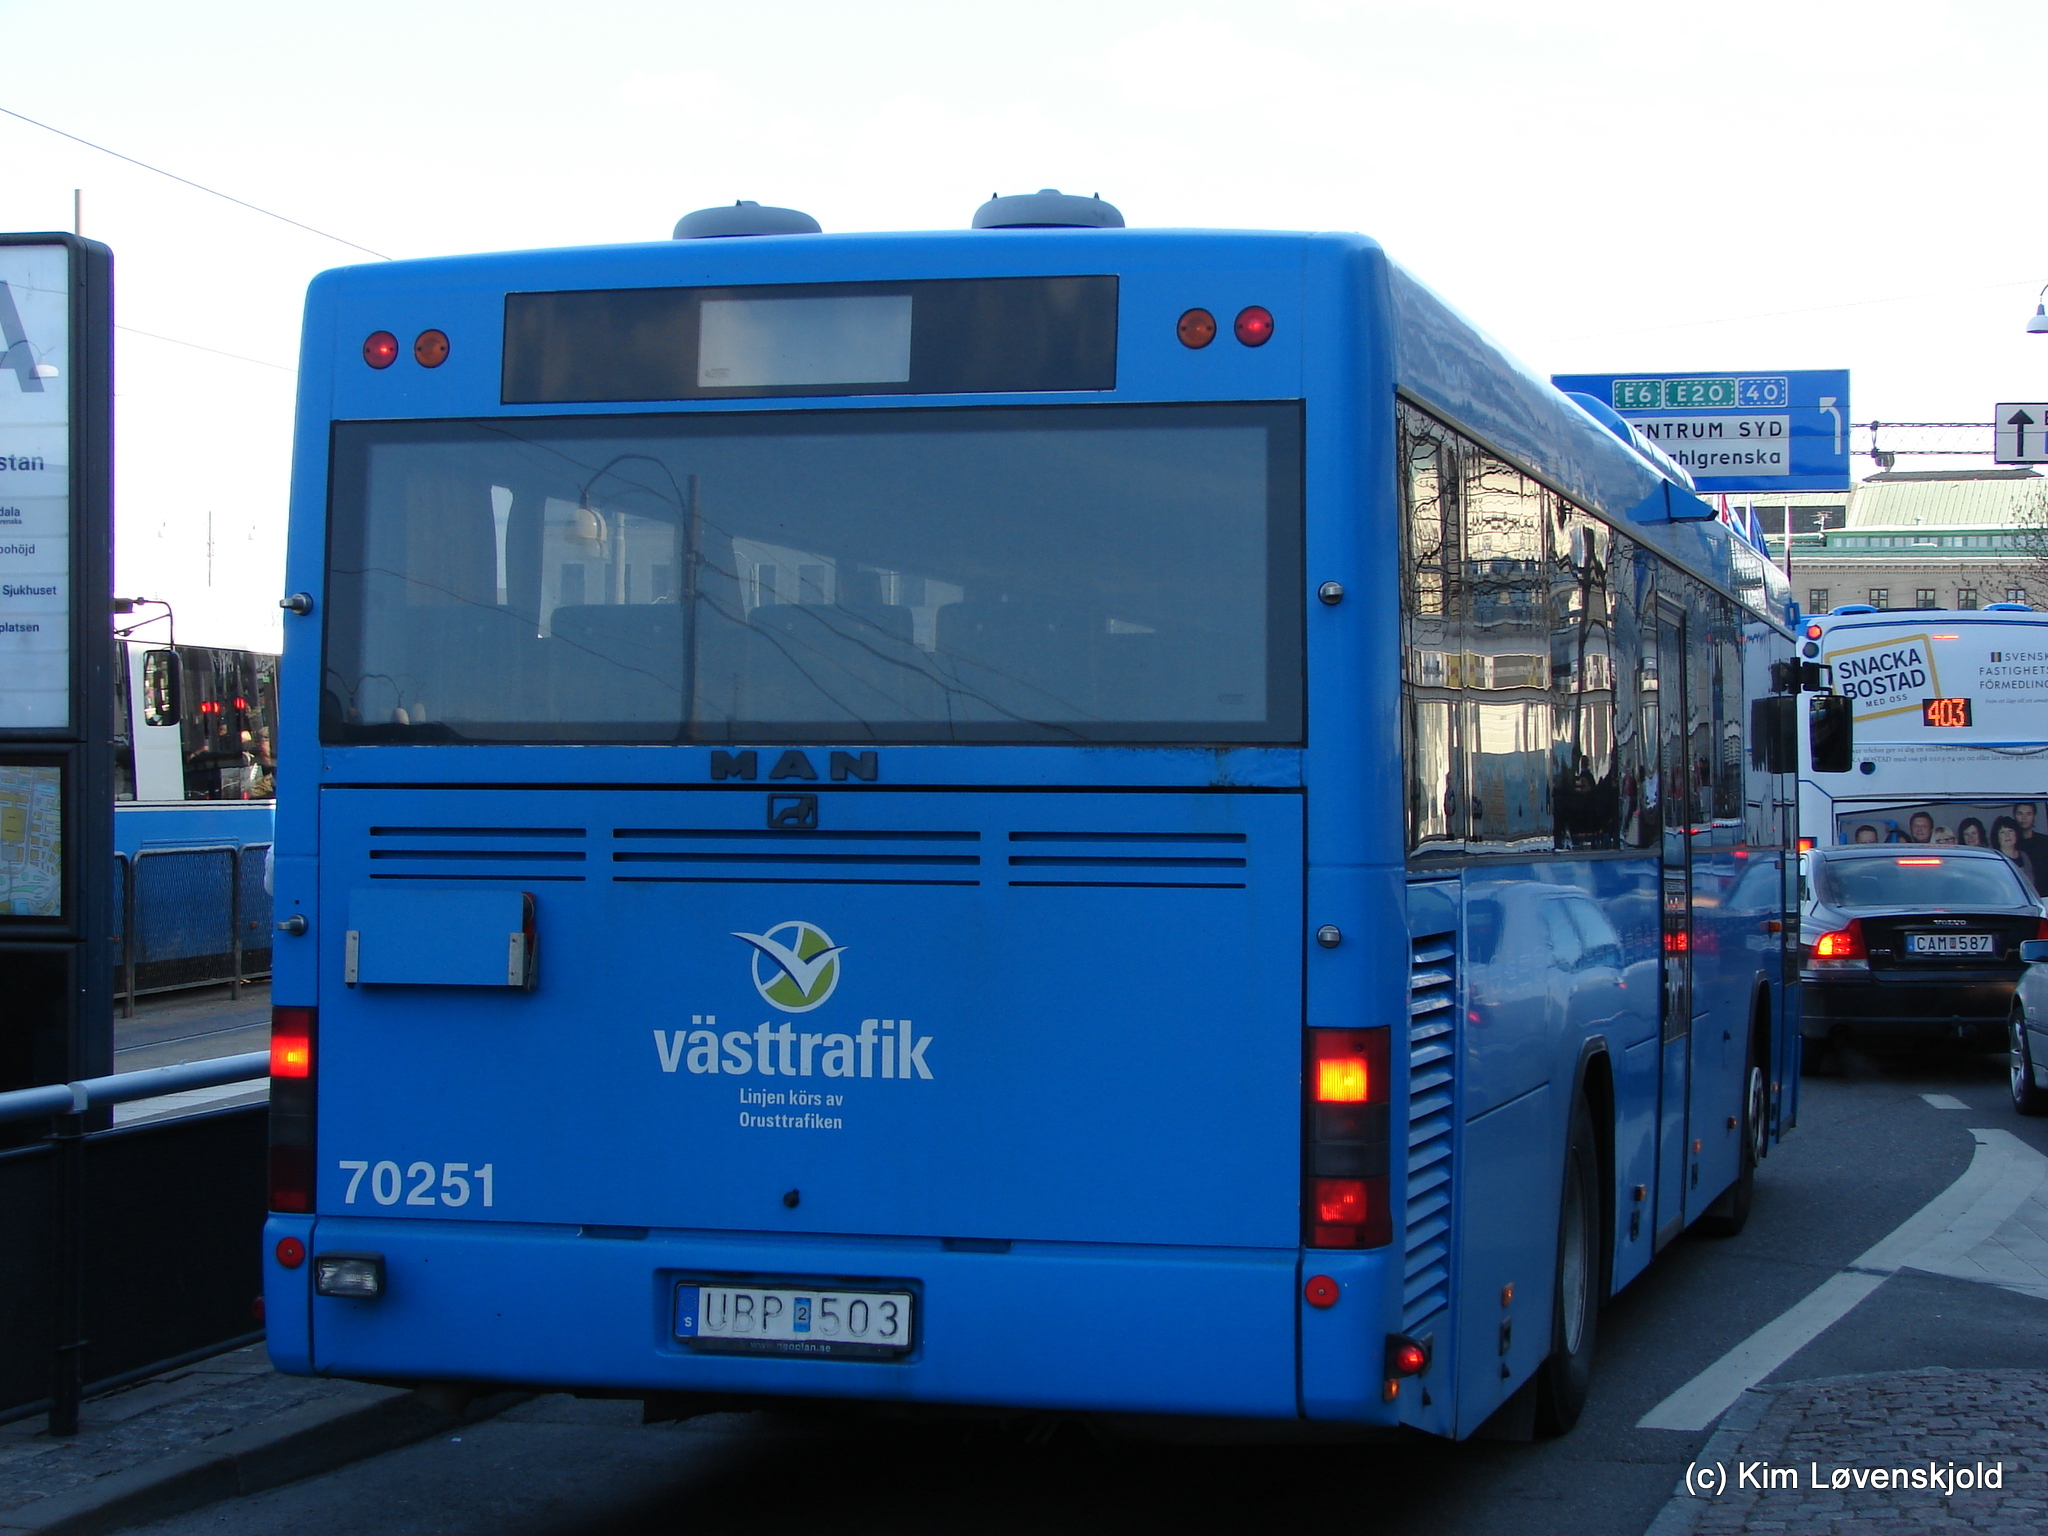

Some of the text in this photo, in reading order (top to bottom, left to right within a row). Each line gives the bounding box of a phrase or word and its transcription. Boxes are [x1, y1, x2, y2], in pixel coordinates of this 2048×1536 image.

[1624, 385, 1652, 403] E6
[1677, 384, 1724, 402] E20
[1746, 384, 1778, 401] 40
[1739, 421, 1782, 438] SYD
[3, 584, 57, 598] Sjukhuset
[1839, 648, 1922, 679] SNACKA
[1842, 669, 1926, 700] BOSTAD
[1866, 694, 1908, 707] MED OSS
[1928, 699, 1965, 727] 403
[711, 750, 878, 781] MAN
[1916, 936, 1947, 951] CAM
[1958, 936, 1989, 950] 587
[653, 1015, 934, 1080] västtrafik
[739, 1088, 844, 1108] Linjen körs av
[739, 1111, 843, 1130] Orusttrafiken
[339, 1160, 493, 1207] 70251
[684, 1317, 693, 1328] S
[705, 1292, 899, 1338] UBP 503
[797, 1307, 807, 1321] 2
